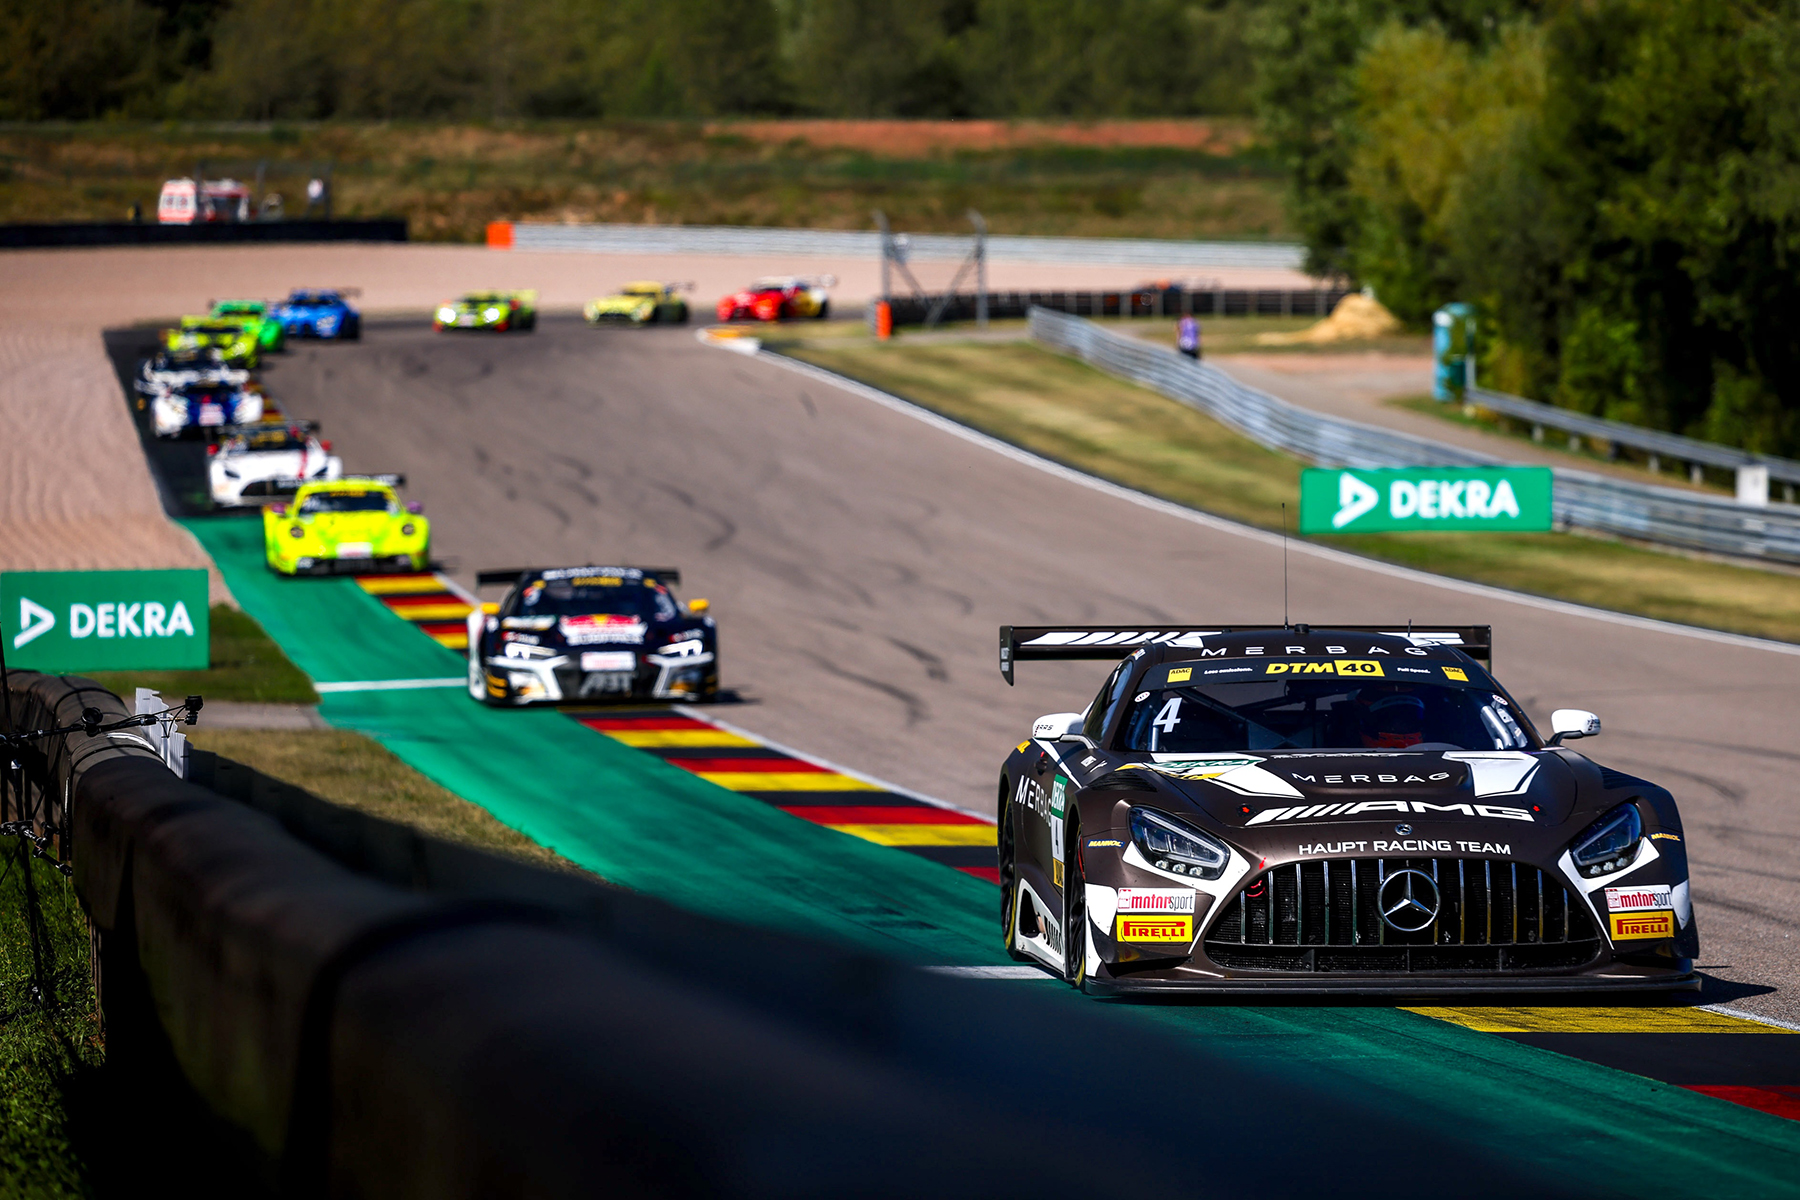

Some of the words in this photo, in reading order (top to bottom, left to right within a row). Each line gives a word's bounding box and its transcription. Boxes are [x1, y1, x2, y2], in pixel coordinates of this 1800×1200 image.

[1389, 478, 1520, 519] DEKRA
[70, 601, 194, 638] DEKRA
[1201, 646, 1428, 657] MERBAG
[1265, 663, 1335, 674] DTM
[1342, 663, 1376, 673] 40
[1153, 697, 1182, 733] 4
[1291, 772, 1450, 783] MERBAG
[1344, 800, 1535, 822] AMG
[1299, 841, 1367, 855] HAUPT
[1373, 840, 1452, 852] RACING
[1456, 841, 1511, 855] TEAM
[1131, 894, 1193, 911] motorsport
[1620, 891, 1672, 908] motorsport
[1123, 921, 1186, 937] PIRELLI
[1616, 917, 1669, 935] PIRELLI
